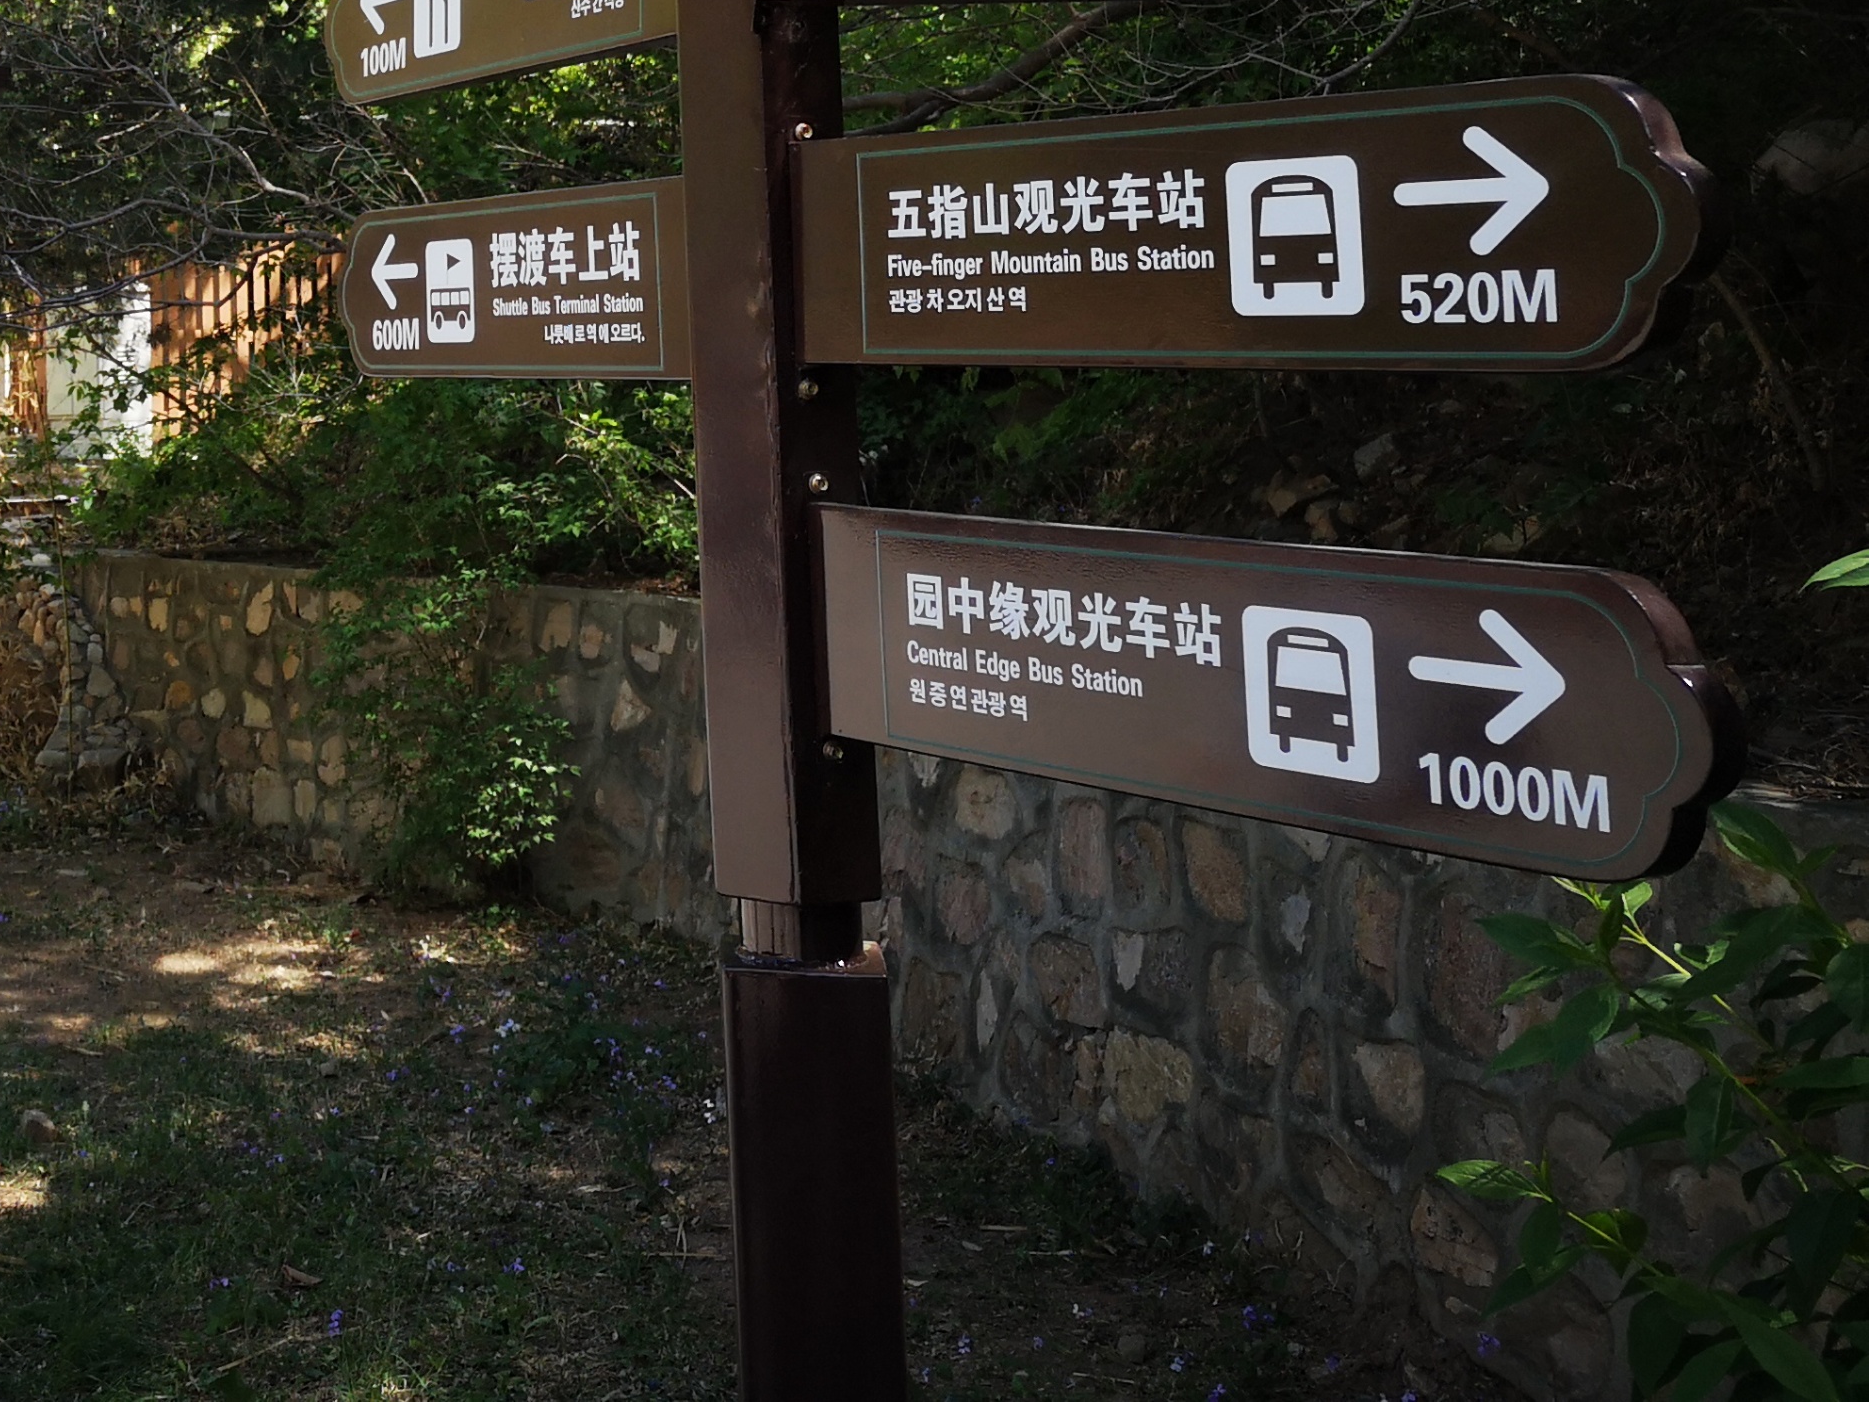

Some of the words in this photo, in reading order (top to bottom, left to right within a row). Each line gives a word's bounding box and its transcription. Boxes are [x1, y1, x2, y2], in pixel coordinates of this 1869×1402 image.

[360, 36, 407, 78] 100M
[887, 168, 1206, 239] 五指山观光车站
[489, 220, 641, 288] 摆渡车上站
[887, 252, 983, 281] Five-finger
[990, 248, 1081, 275] Mountain
[1090, 246, 1129, 272] Bus
[1136, 244, 1215, 270] Station
[492, 297, 529, 317] Shuttle
[531, 295, 551, 316] Bus
[553, 293, 600, 315] Terminal
[603, 292, 644, 314] Station
[1398, 268, 1559, 326] 520M
[371, 317, 420, 351] 600M
[906, 572, 1222, 667] 园中缘观光车站
[906, 639, 968, 671] Central
[975, 649, 1021, 682] Edge
[1027, 656, 1064, 686] Bus
[1071, 663, 1144, 698] Station
[1418, 753, 1612, 834] 1000M
